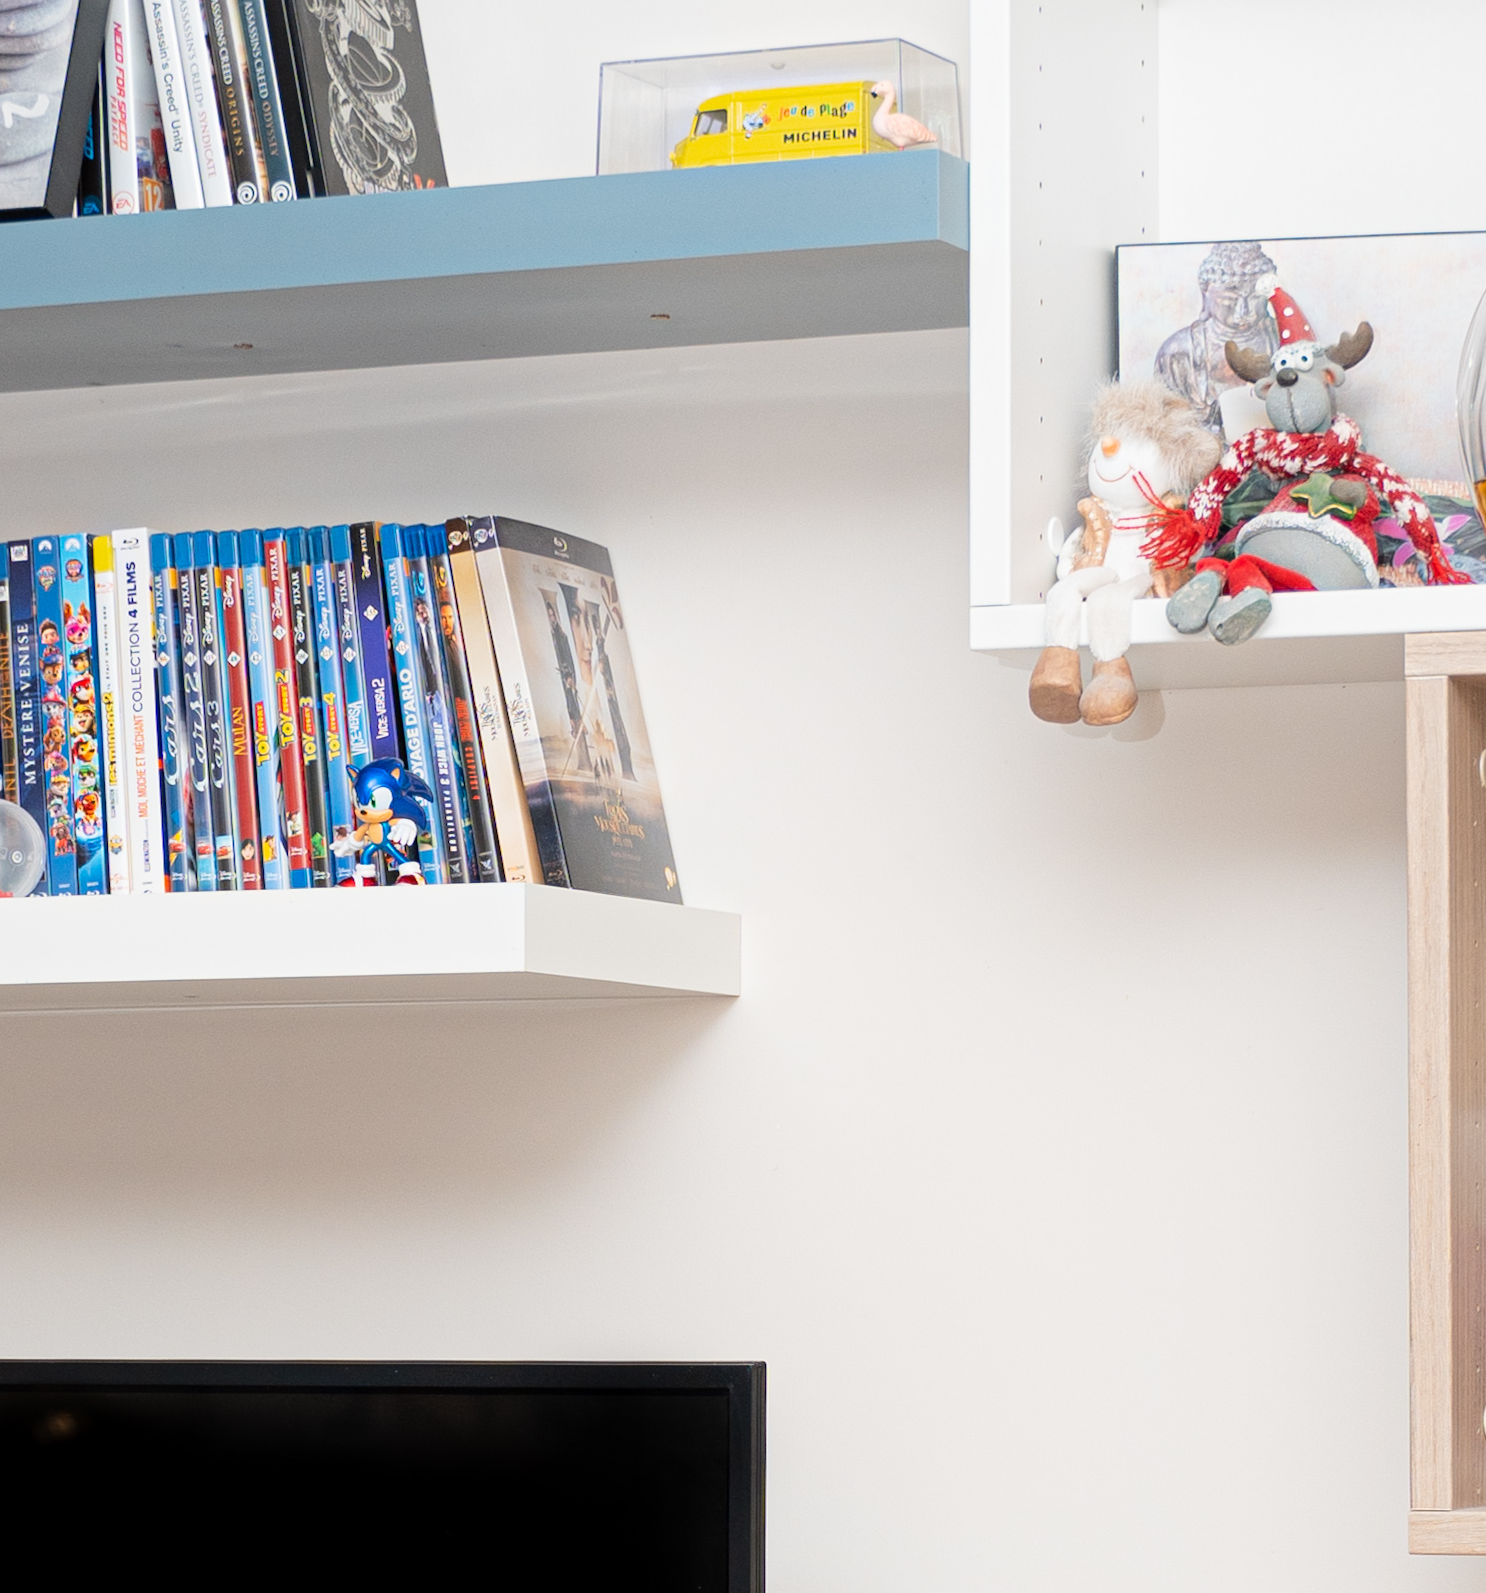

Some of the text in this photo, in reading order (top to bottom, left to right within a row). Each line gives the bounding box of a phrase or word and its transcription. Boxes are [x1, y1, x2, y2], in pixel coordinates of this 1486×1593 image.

[113, 22, 128, 151] NEED FOR SPEED
[152, 2, 183, 153] Assassin's Creed Unity
[179, 0, 198, 61] ASSASSIN'S
[198, 111, 217, 178] SYNDICATE
[219, 47, 233, 85] CREED
[226, 87, 244, 156] ORIGINS
[243, 1, 279, 157] ASSASSIN'S CREED ODYSSEY
[110, 95, 119, 147] PAYBACK
[782, 128, 857, 144] MICHELIN
[16, 623, 37, 784] MYSTÈRE VENISE
[126, 561, 149, 818] MOI, MOCHE ET MÉCHANT COLLECTION 4 FILMS
[275, 669, 295, 747] TOY STORY 2
[372, 678, 389, 739] VICE-VERSA 2
[399, 668, 417, 725] D'ARLO
[161, 690, 179, 786] Cars
[231, 706, 247, 756] MULAN
[255, 704, 271, 766] TOY STORY
[299, 696, 317, 765] TOY STORY 3
[322, 692, 341, 762] TOY STORY 4
[348, 701, 369, 756] VICE-VERSA
[432, 722, 443, 748] JOHN
[436, 749, 449, 775] WICK
[443, 790, 457, 852] PARABELLUM
